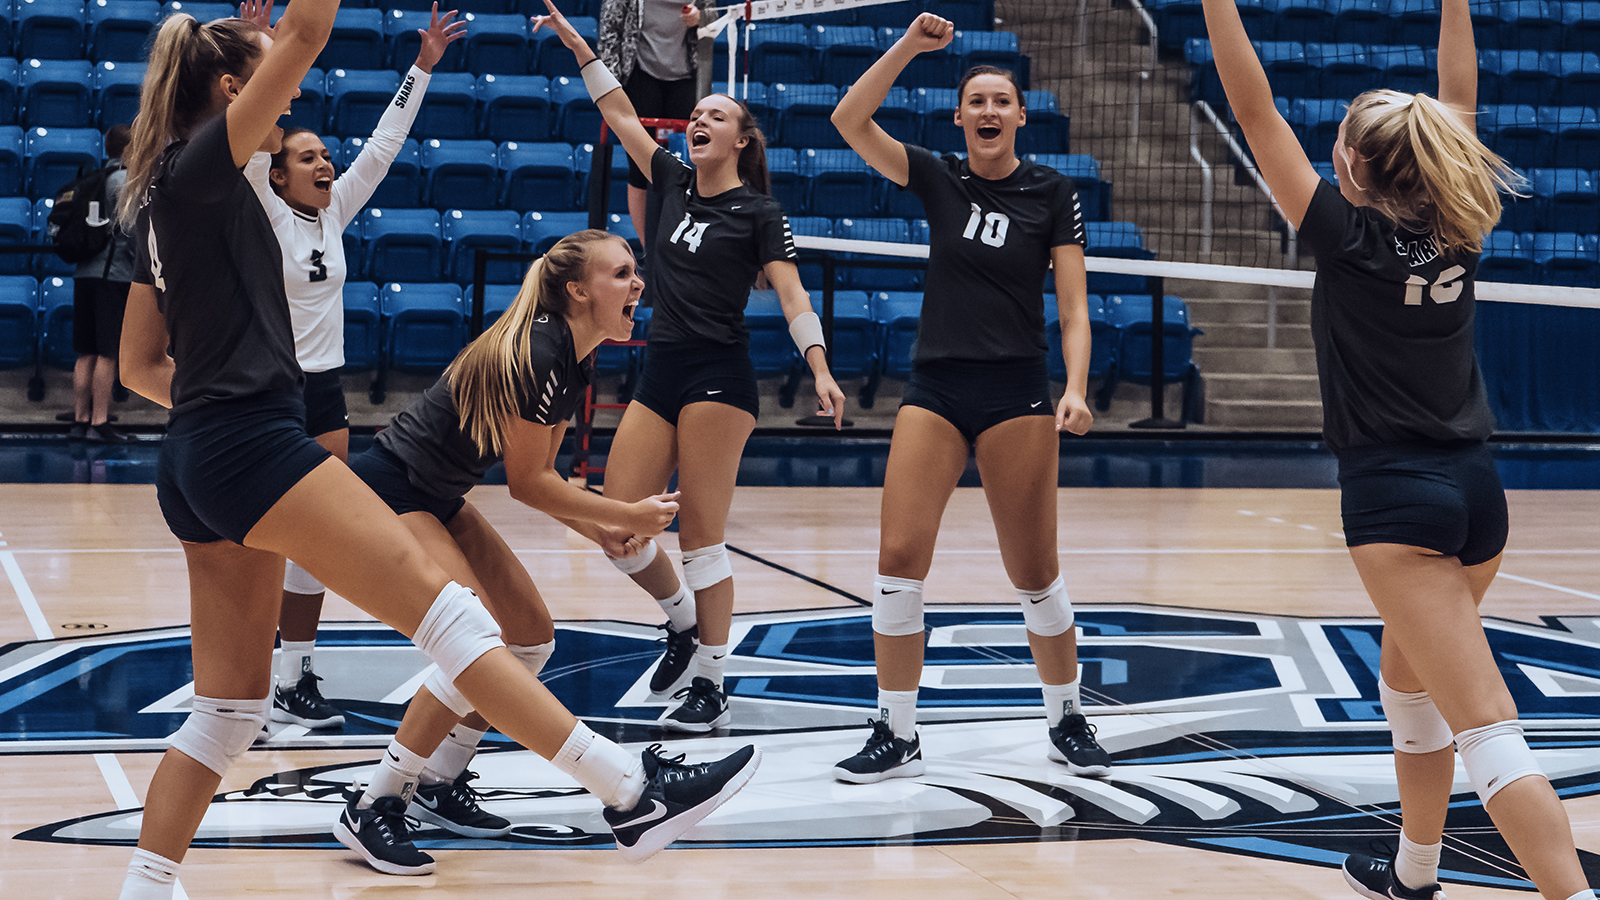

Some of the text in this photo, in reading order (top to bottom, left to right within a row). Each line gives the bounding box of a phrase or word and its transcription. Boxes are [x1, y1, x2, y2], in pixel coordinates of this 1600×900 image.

[395, 74, 416, 109] SHARKS
[669, 212, 711, 254] 14
[962, 202, 1010, 248] 10
[309, 249, 328, 283] 3
